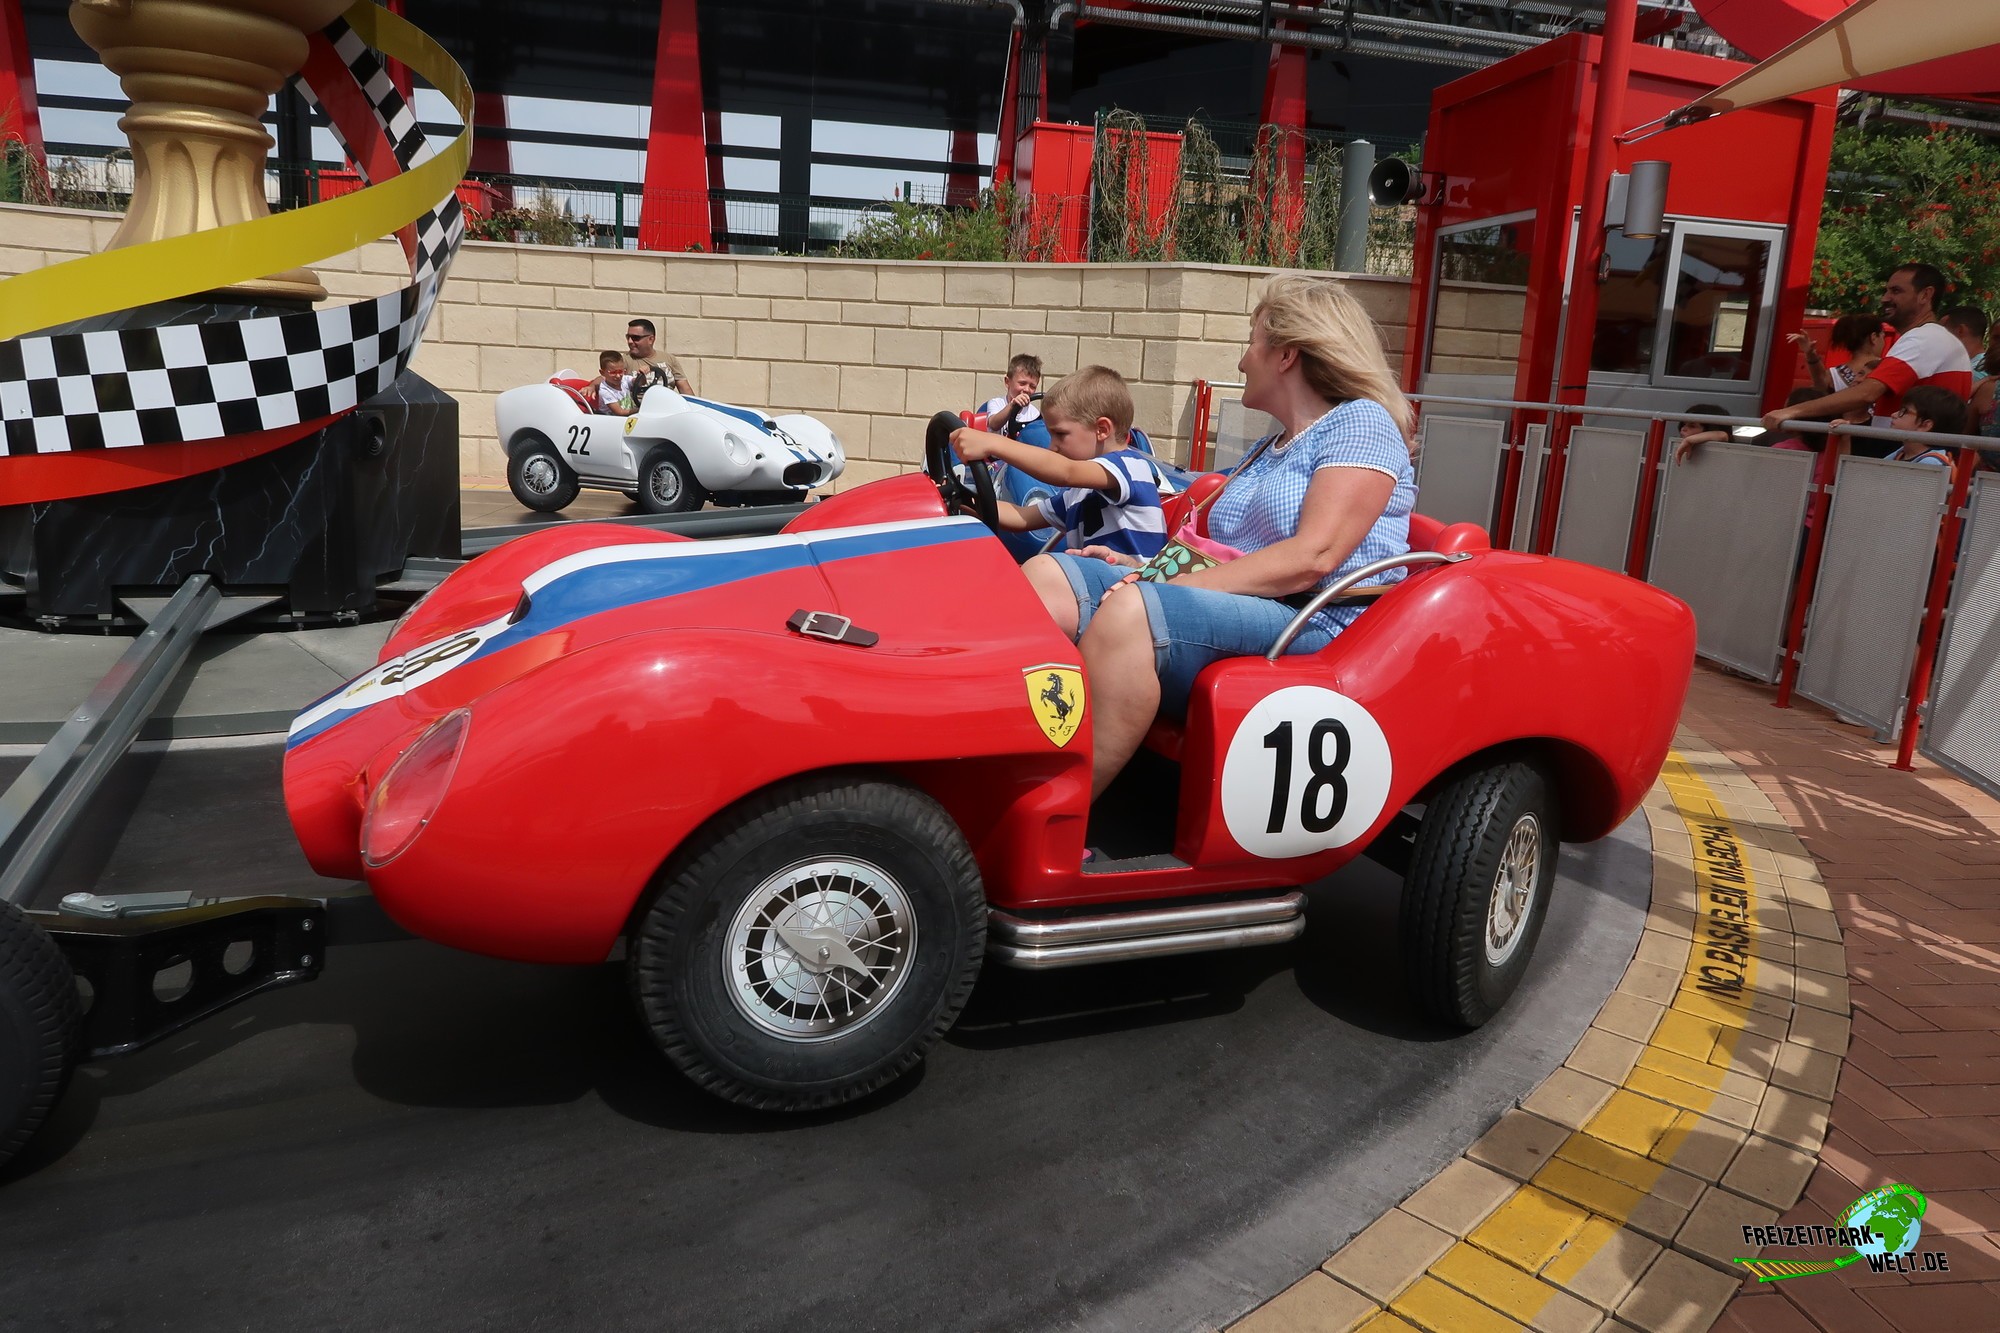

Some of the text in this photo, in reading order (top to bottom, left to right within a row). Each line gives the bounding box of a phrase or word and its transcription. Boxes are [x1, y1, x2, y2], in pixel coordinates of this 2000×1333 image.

[567, 424, 592, 456] 22
[772, 430, 802, 446] 22
[1048, 725, 1057, 737] S
[1263, 717, 1351, 834] 18
[1696, 824, 1750, 1000] NO PASAR EN MARCHA
